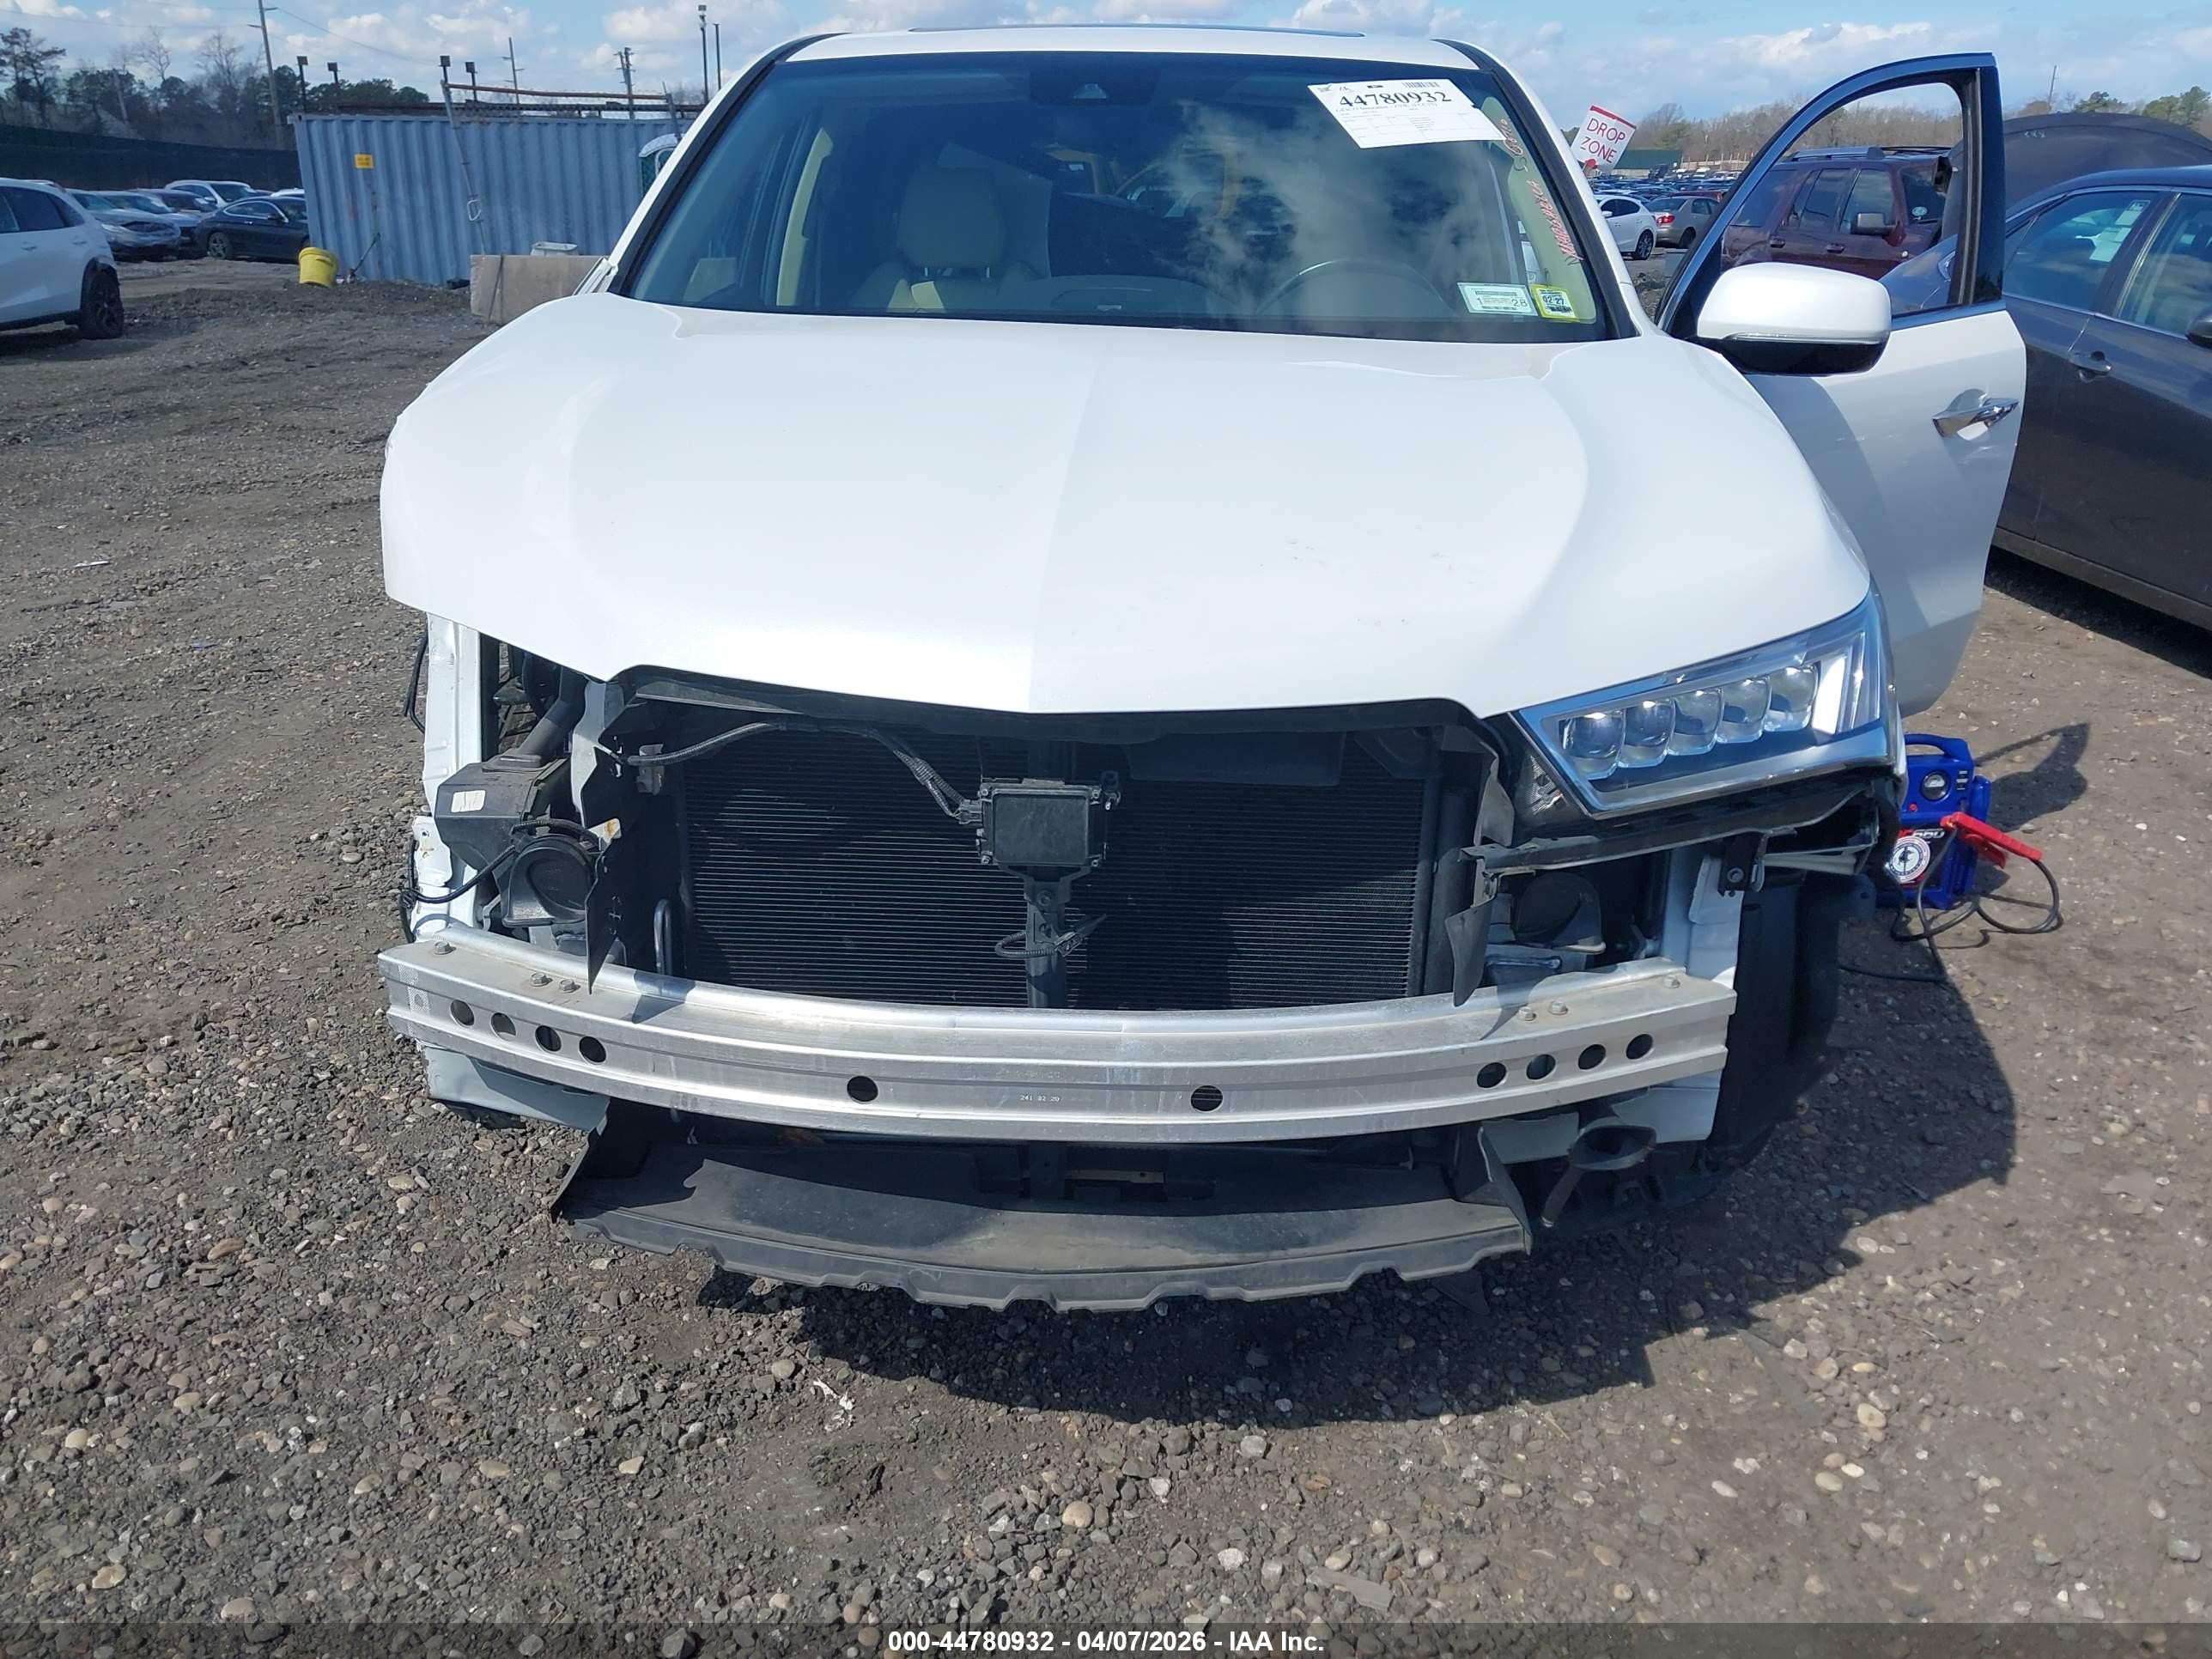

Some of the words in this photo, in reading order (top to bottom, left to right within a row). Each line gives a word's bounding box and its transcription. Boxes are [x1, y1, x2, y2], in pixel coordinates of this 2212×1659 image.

[1340, 91, 1452, 106] 44780932
[1586, 118, 1626, 144] DROP
[1580, 136, 1617, 164] ZONE
[1511, 298, 1528, 307] 28
